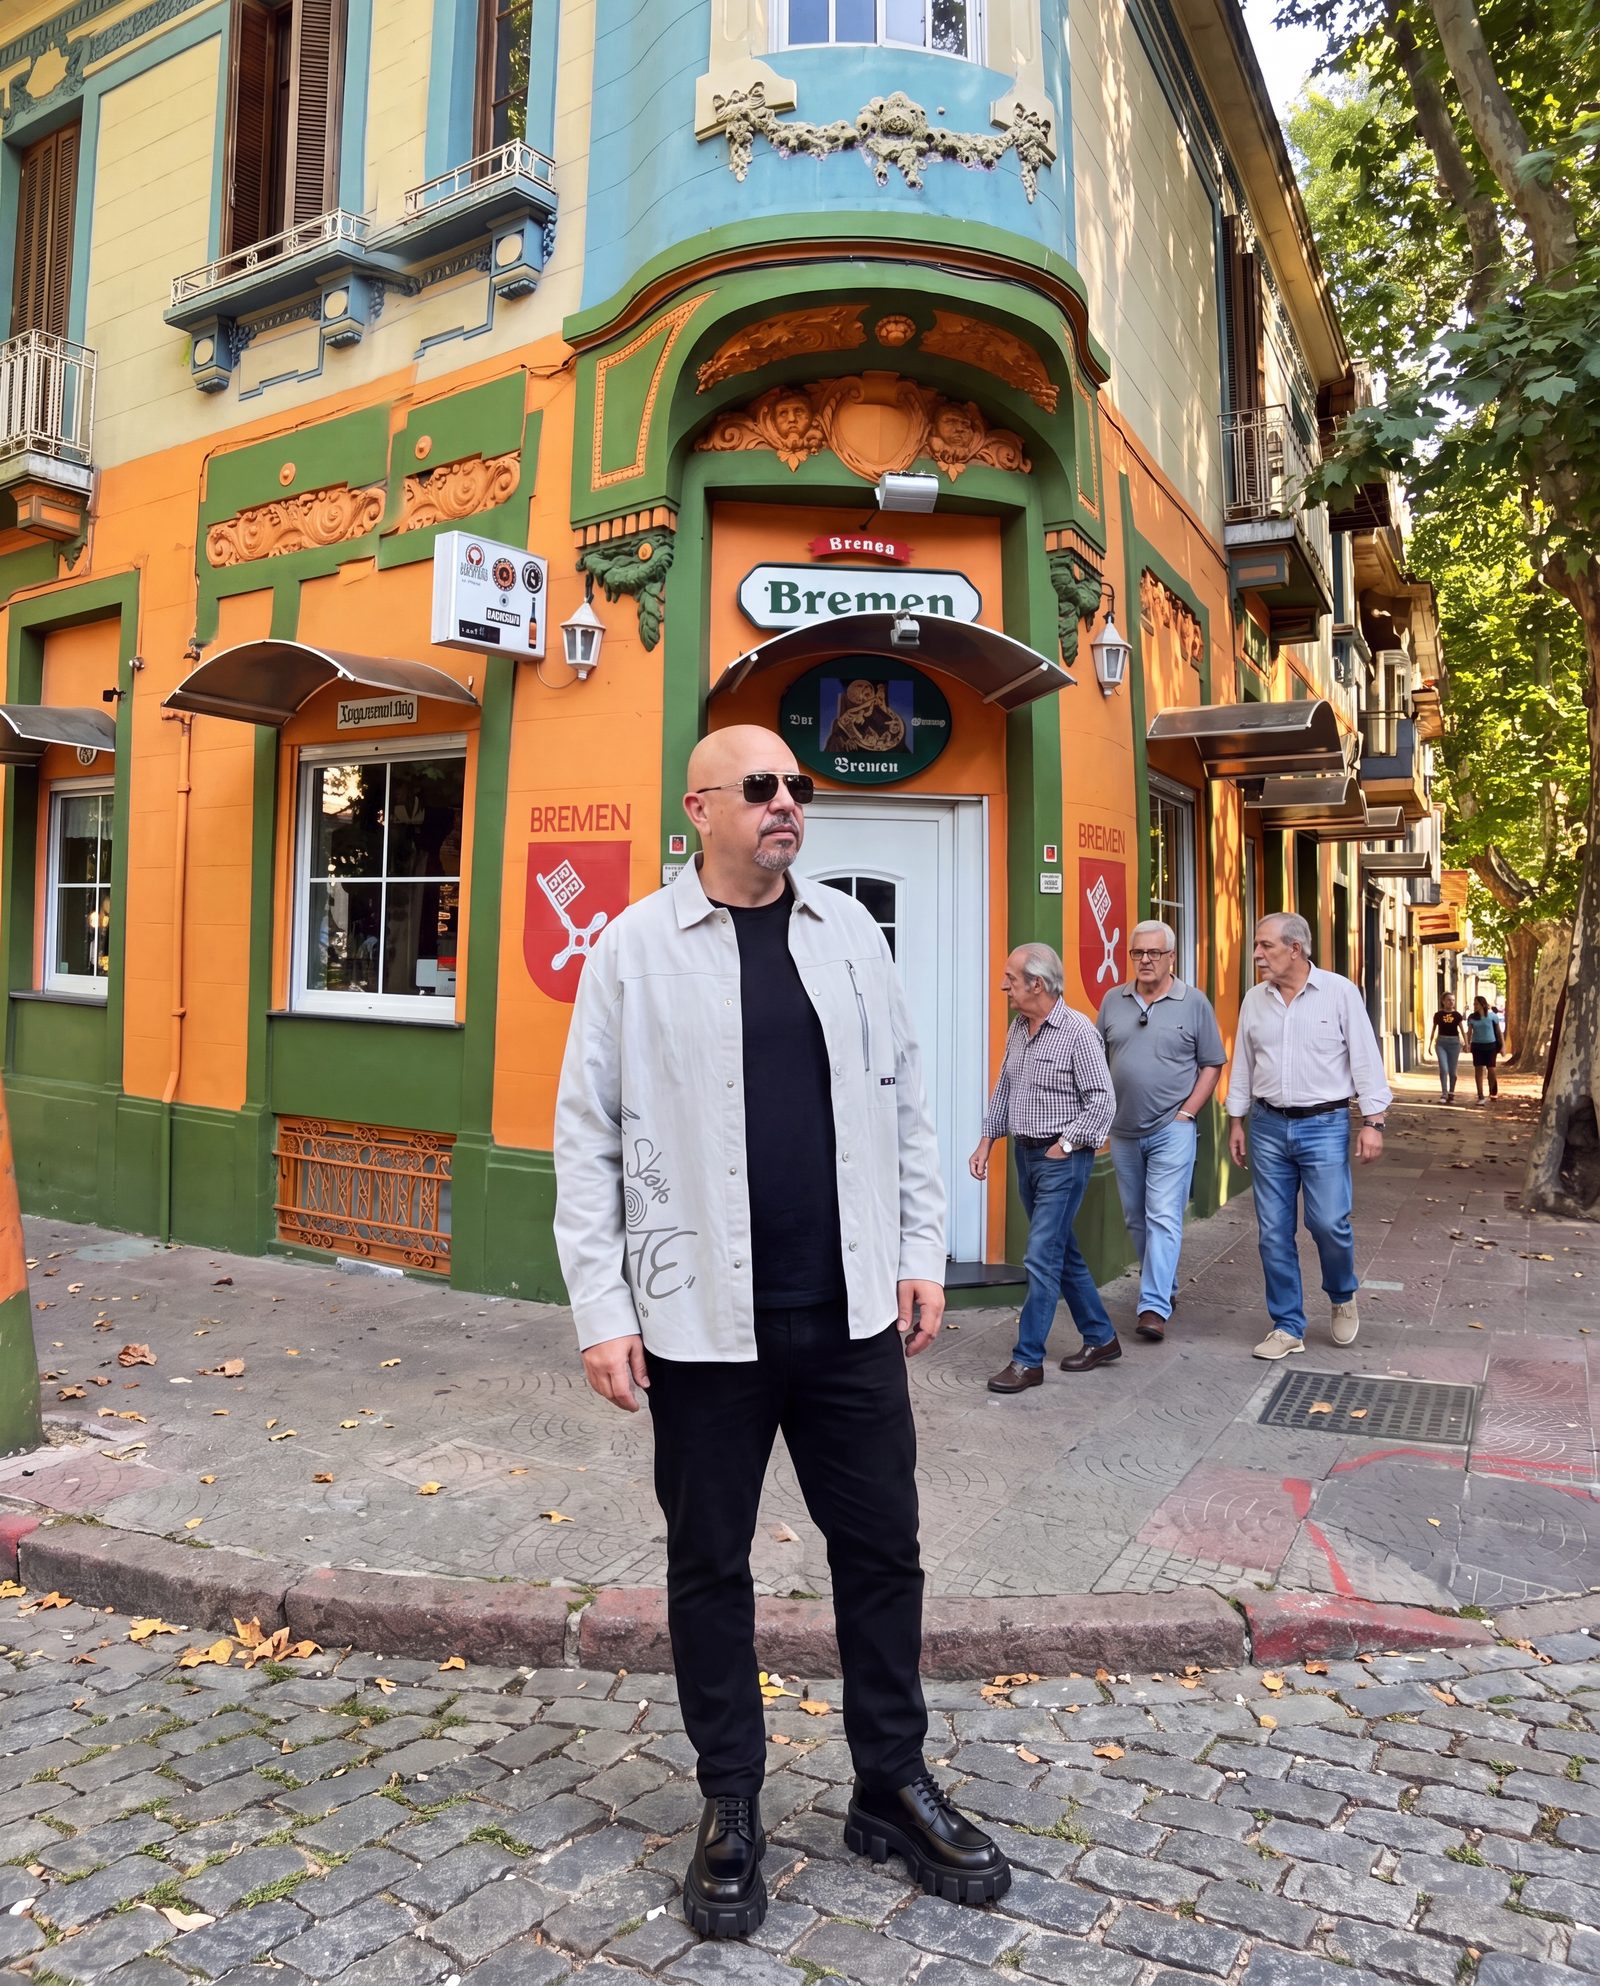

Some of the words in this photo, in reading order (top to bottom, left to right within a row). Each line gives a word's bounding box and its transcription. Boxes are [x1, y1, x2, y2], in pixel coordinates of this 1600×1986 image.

[829, 537, 895, 555] Brenea
[768, 580, 956, 618] Bremen
[530, 803, 631, 833] BREMEN
[1078, 823, 1125, 854] BREMEN
